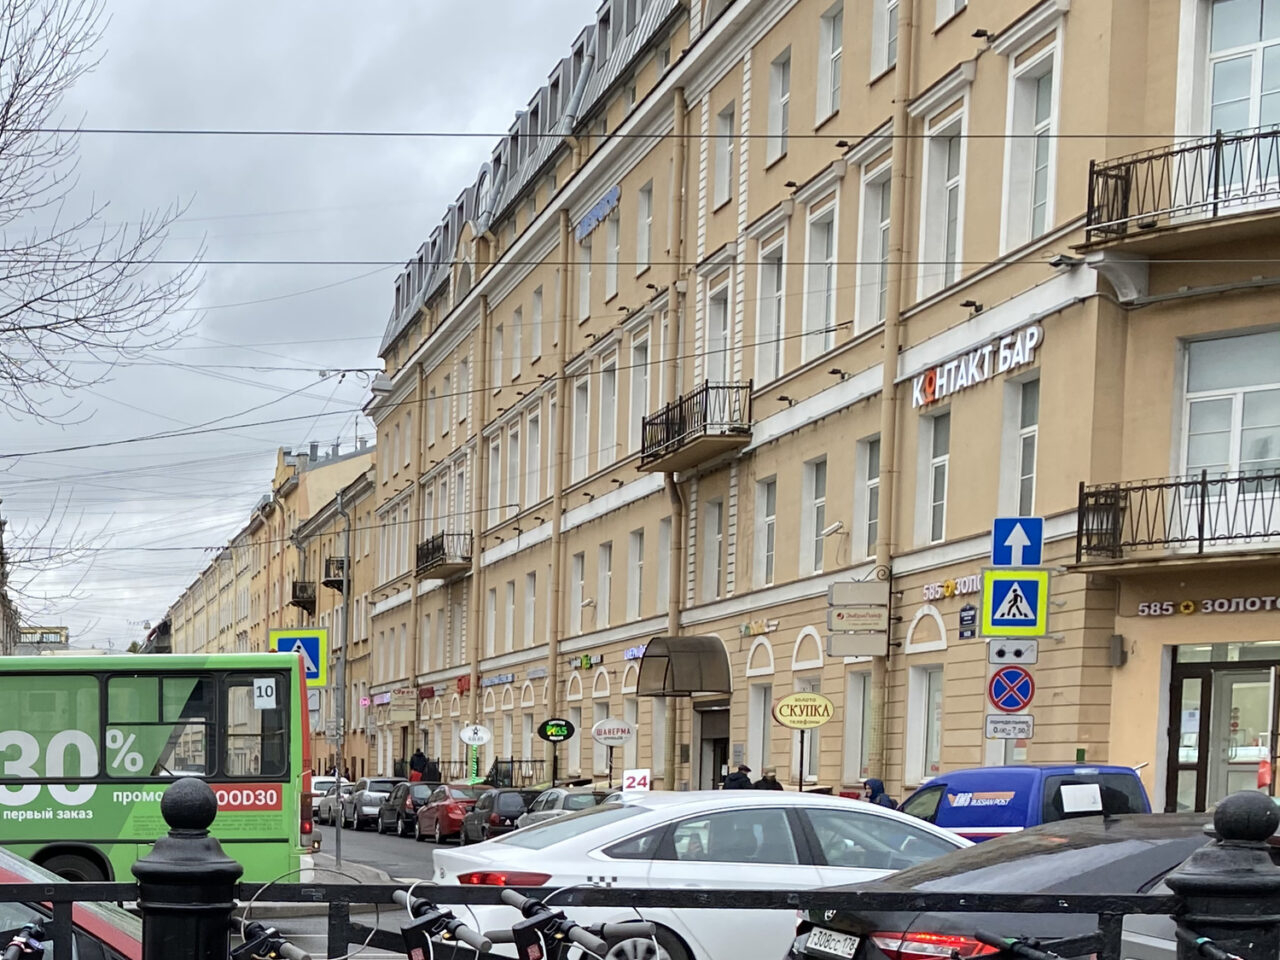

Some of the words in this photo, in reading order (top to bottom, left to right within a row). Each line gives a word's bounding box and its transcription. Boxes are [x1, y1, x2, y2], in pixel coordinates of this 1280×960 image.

[912, 345, 993, 409] КОНТАКТ
[998, 325, 1042, 373] БАР
[923, 583, 942, 600] 585
[1138, 602, 1174, 616] 585
[256, 685, 274, 698] 10
[625, 776, 648, 788] 24
[113, 792, 162, 804] промо
[214, 790, 277, 805] OOD30
[3, 808, 53, 822] первый
[56, 810, 93, 819] заказ
[842, 935, 856, 951] 178
